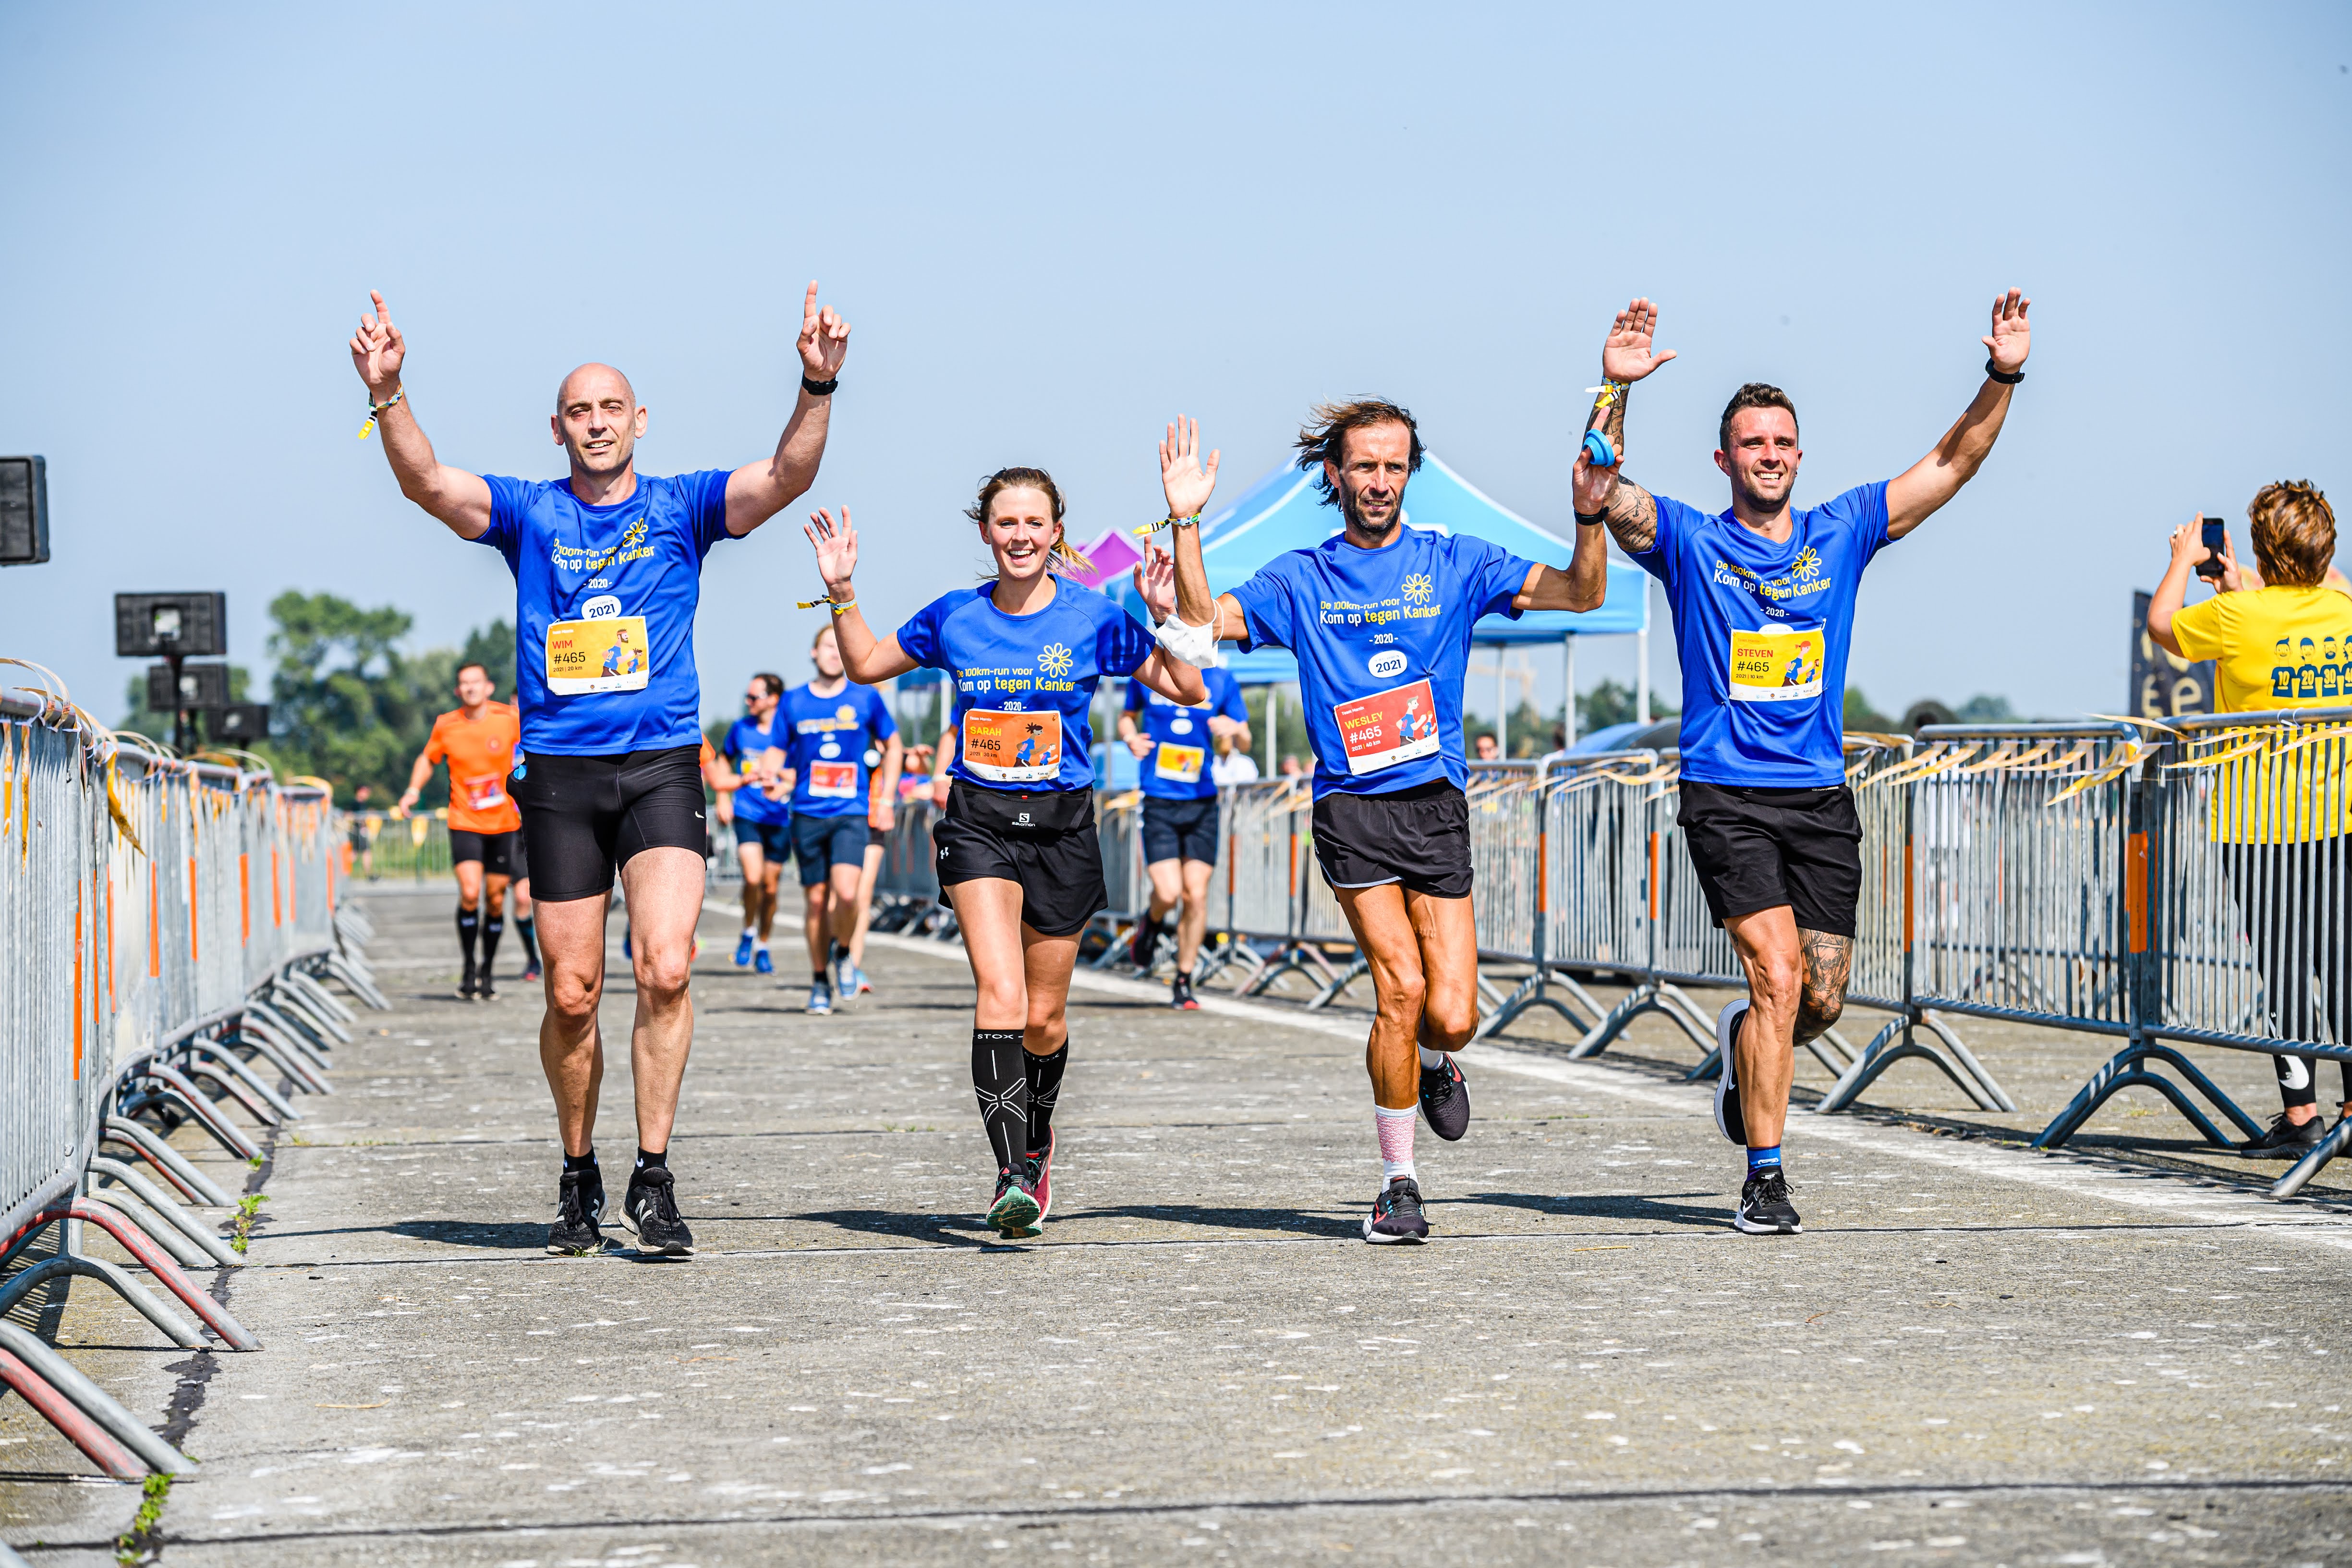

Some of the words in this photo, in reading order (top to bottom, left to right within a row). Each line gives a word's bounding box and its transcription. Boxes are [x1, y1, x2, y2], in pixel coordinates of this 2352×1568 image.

[569, 559, 582, 573] op
[618, 546, 655, 564] Kanker
[1716, 559, 1728, 570] De
[1771, 577, 1791, 587] voor
[1713, 569, 1740, 588] Kom
[1743, 580, 1756, 594] op
[1759, 582, 1792, 601] tegen
[1793, 577, 1831, 597] Kanker
[589, 604, 615, 618] 2021
[1321, 601, 1331, 609] De
[1334, 601, 1378, 610] 100km-run
[1380, 598, 1400, 607] voor
[1320, 610, 1344, 624] Kom
[1347, 613, 1362, 627] op
[1364, 609, 1400, 625] tegen
[1403, 604, 1441, 619] Kanker
[552, 640, 572, 649] WIM
[554, 652, 585, 664] #465
[1737, 648, 1773, 657] STEVEN
[965, 667, 1009, 677] 100km-run
[1376, 659, 1401, 673] 2021
[1737, 661, 1769, 672] #465
[2278, 670, 2290, 686] 10
[2302, 669, 2315, 686] 20
[2324, 668, 2336, 684] 30
[958, 679, 974, 692] Kom
[977, 679, 991, 693] op
[994, 677, 1031, 693] tegen
[1035, 677, 1076, 692] Kanker
[1345, 711, 1382, 729] WESLEY
[970, 726, 1001, 736] SARAH
[1349, 725, 1382, 744] #465
[971, 739, 1000, 751] #465
